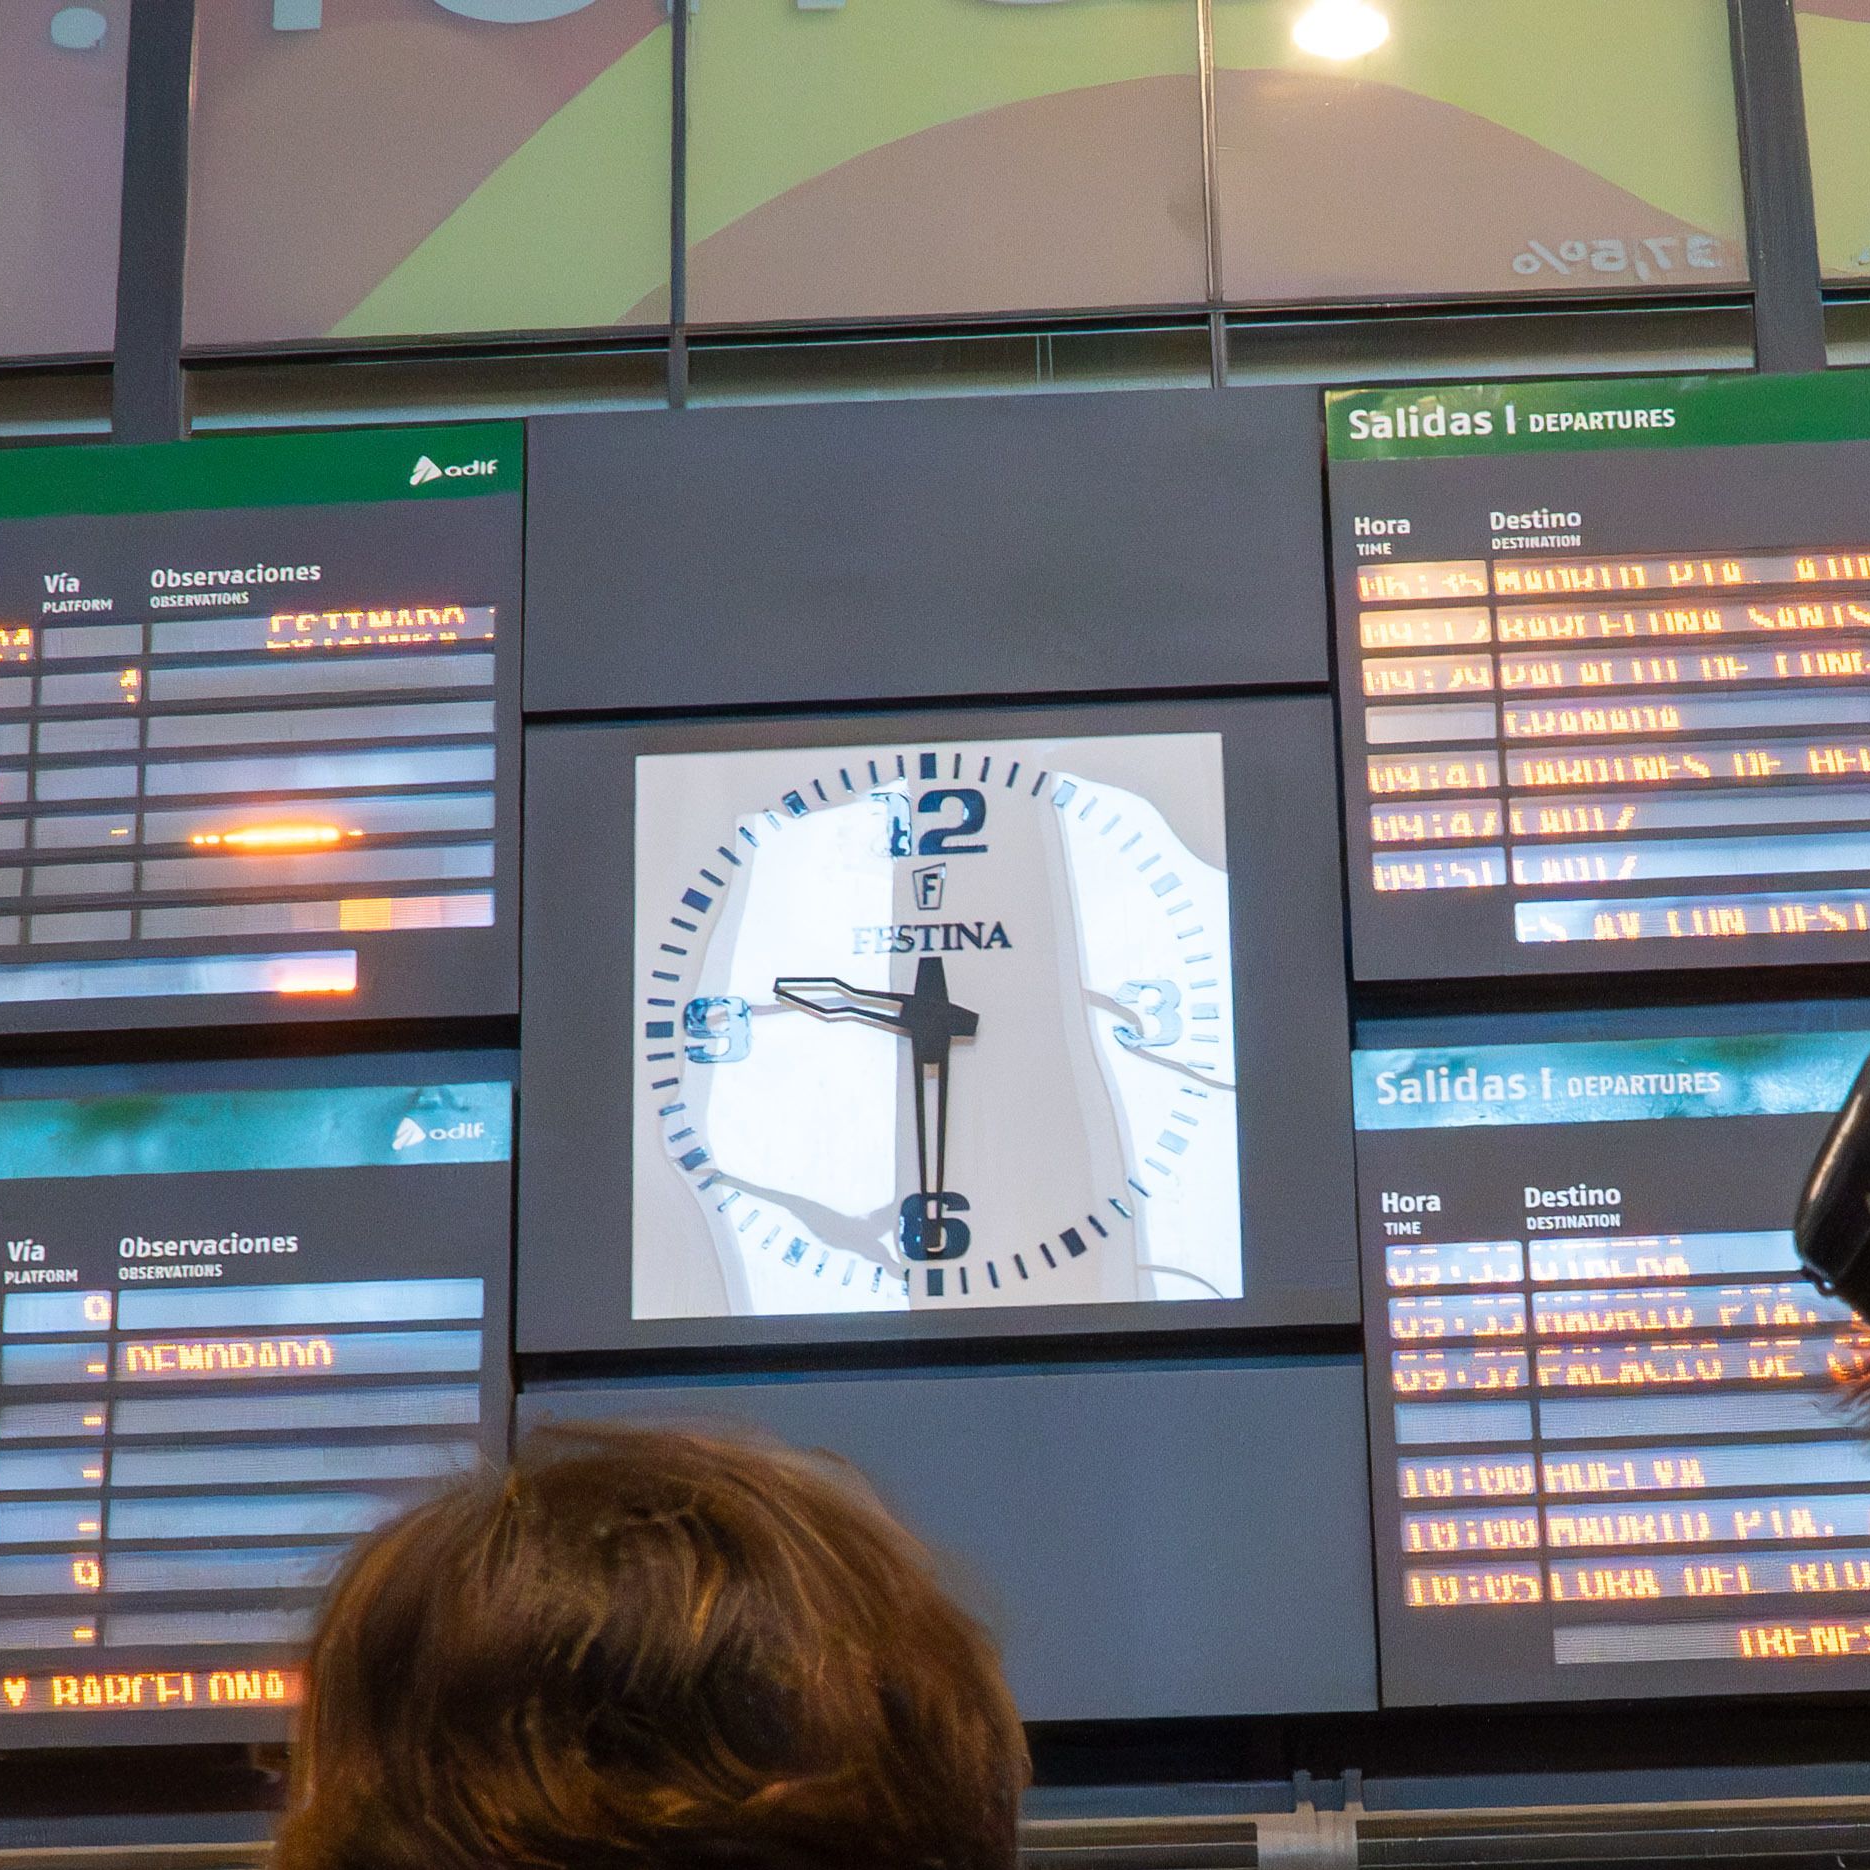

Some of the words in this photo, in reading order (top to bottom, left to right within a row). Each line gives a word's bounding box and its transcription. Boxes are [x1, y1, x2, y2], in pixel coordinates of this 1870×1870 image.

[1349, 404, 1493, 441] Salidas
[1530, 408, 1676, 433] DEPARTURES
[444, 459, 498, 477] adif
[1354, 516, 1411, 536] Hora
[1490, 508, 1582, 530] Destino
[1356, 542, 1393, 556] TIME
[1491, 534, 1581, 551] DESTINATION
[44, 572, 80, 594] Vía
[151, 564, 321, 589] Observaciones
[42, 597, 113, 613] PLATFORM
[150, 592, 249, 609] OBSERVATIONS
[852, 921, 1013, 954] FESTINA
[1113, 979, 1182, 1046] 3
[683, 996, 752, 1064] 9
[1376, 1066, 1525, 1105] Salidas
[1567, 1071, 1721, 1098] DEPARTURES
[429, 1122, 485, 1140] adif
[1381, 1192, 1442, 1213] Hora
[1524, 1183, 1622, 1208] Destino
[1384, 1221, 1422, 1236] TIME
[1526, 1213, 1621, 1230] DESTINATION
[7, 1239, 46, 1262] Vía
[119, 1232, 299, 1261] Observaciones
[4, 1268, 78, 1285] PLATFORM
[118, 1262, 223, 1281] OBSERVATIONS
